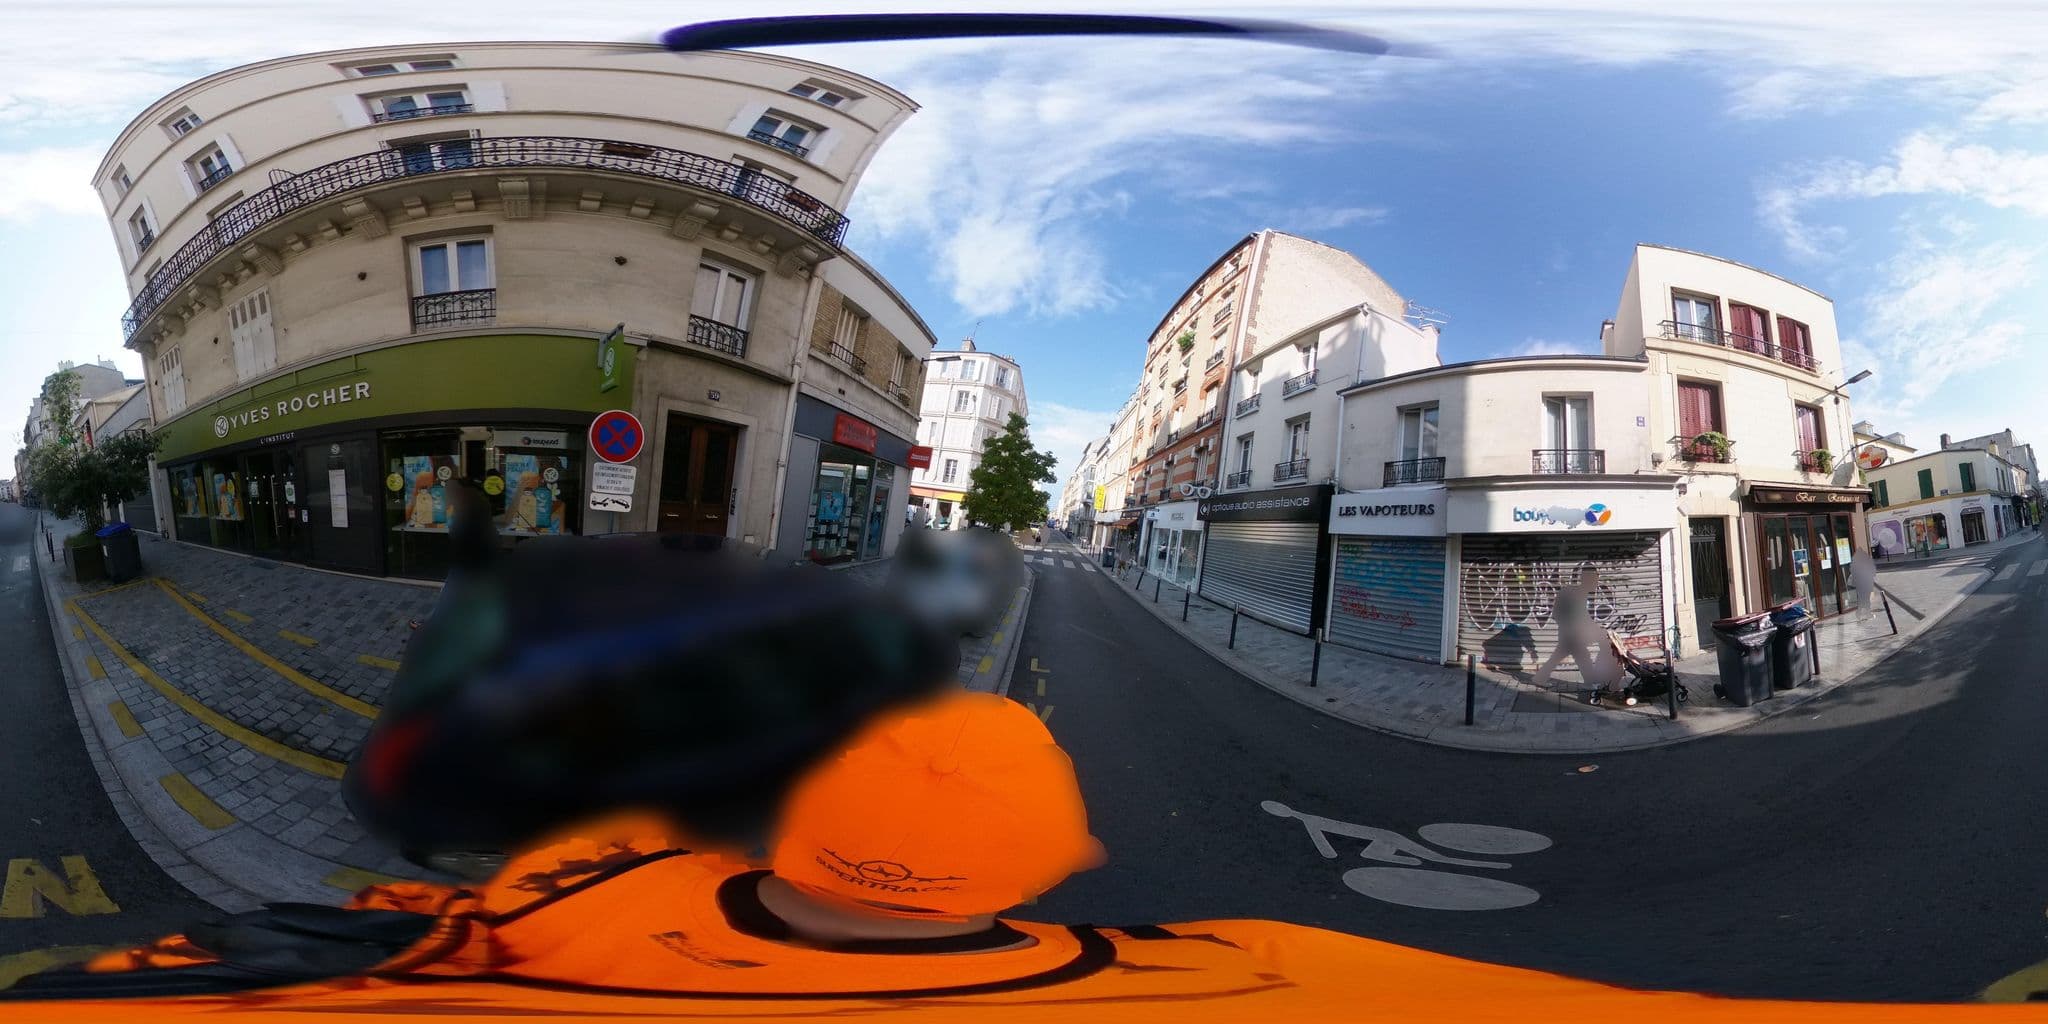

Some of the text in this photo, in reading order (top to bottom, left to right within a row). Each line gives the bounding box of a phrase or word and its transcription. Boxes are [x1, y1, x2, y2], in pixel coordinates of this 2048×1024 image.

[230, 382, 370, 429] YVES ROCHER
[1338, 503, 1436, 517] LES VAPOTEURS
[1795, 491, 1817, 503] Bar
[815, 855, 961, 893] SUPERTRACK
